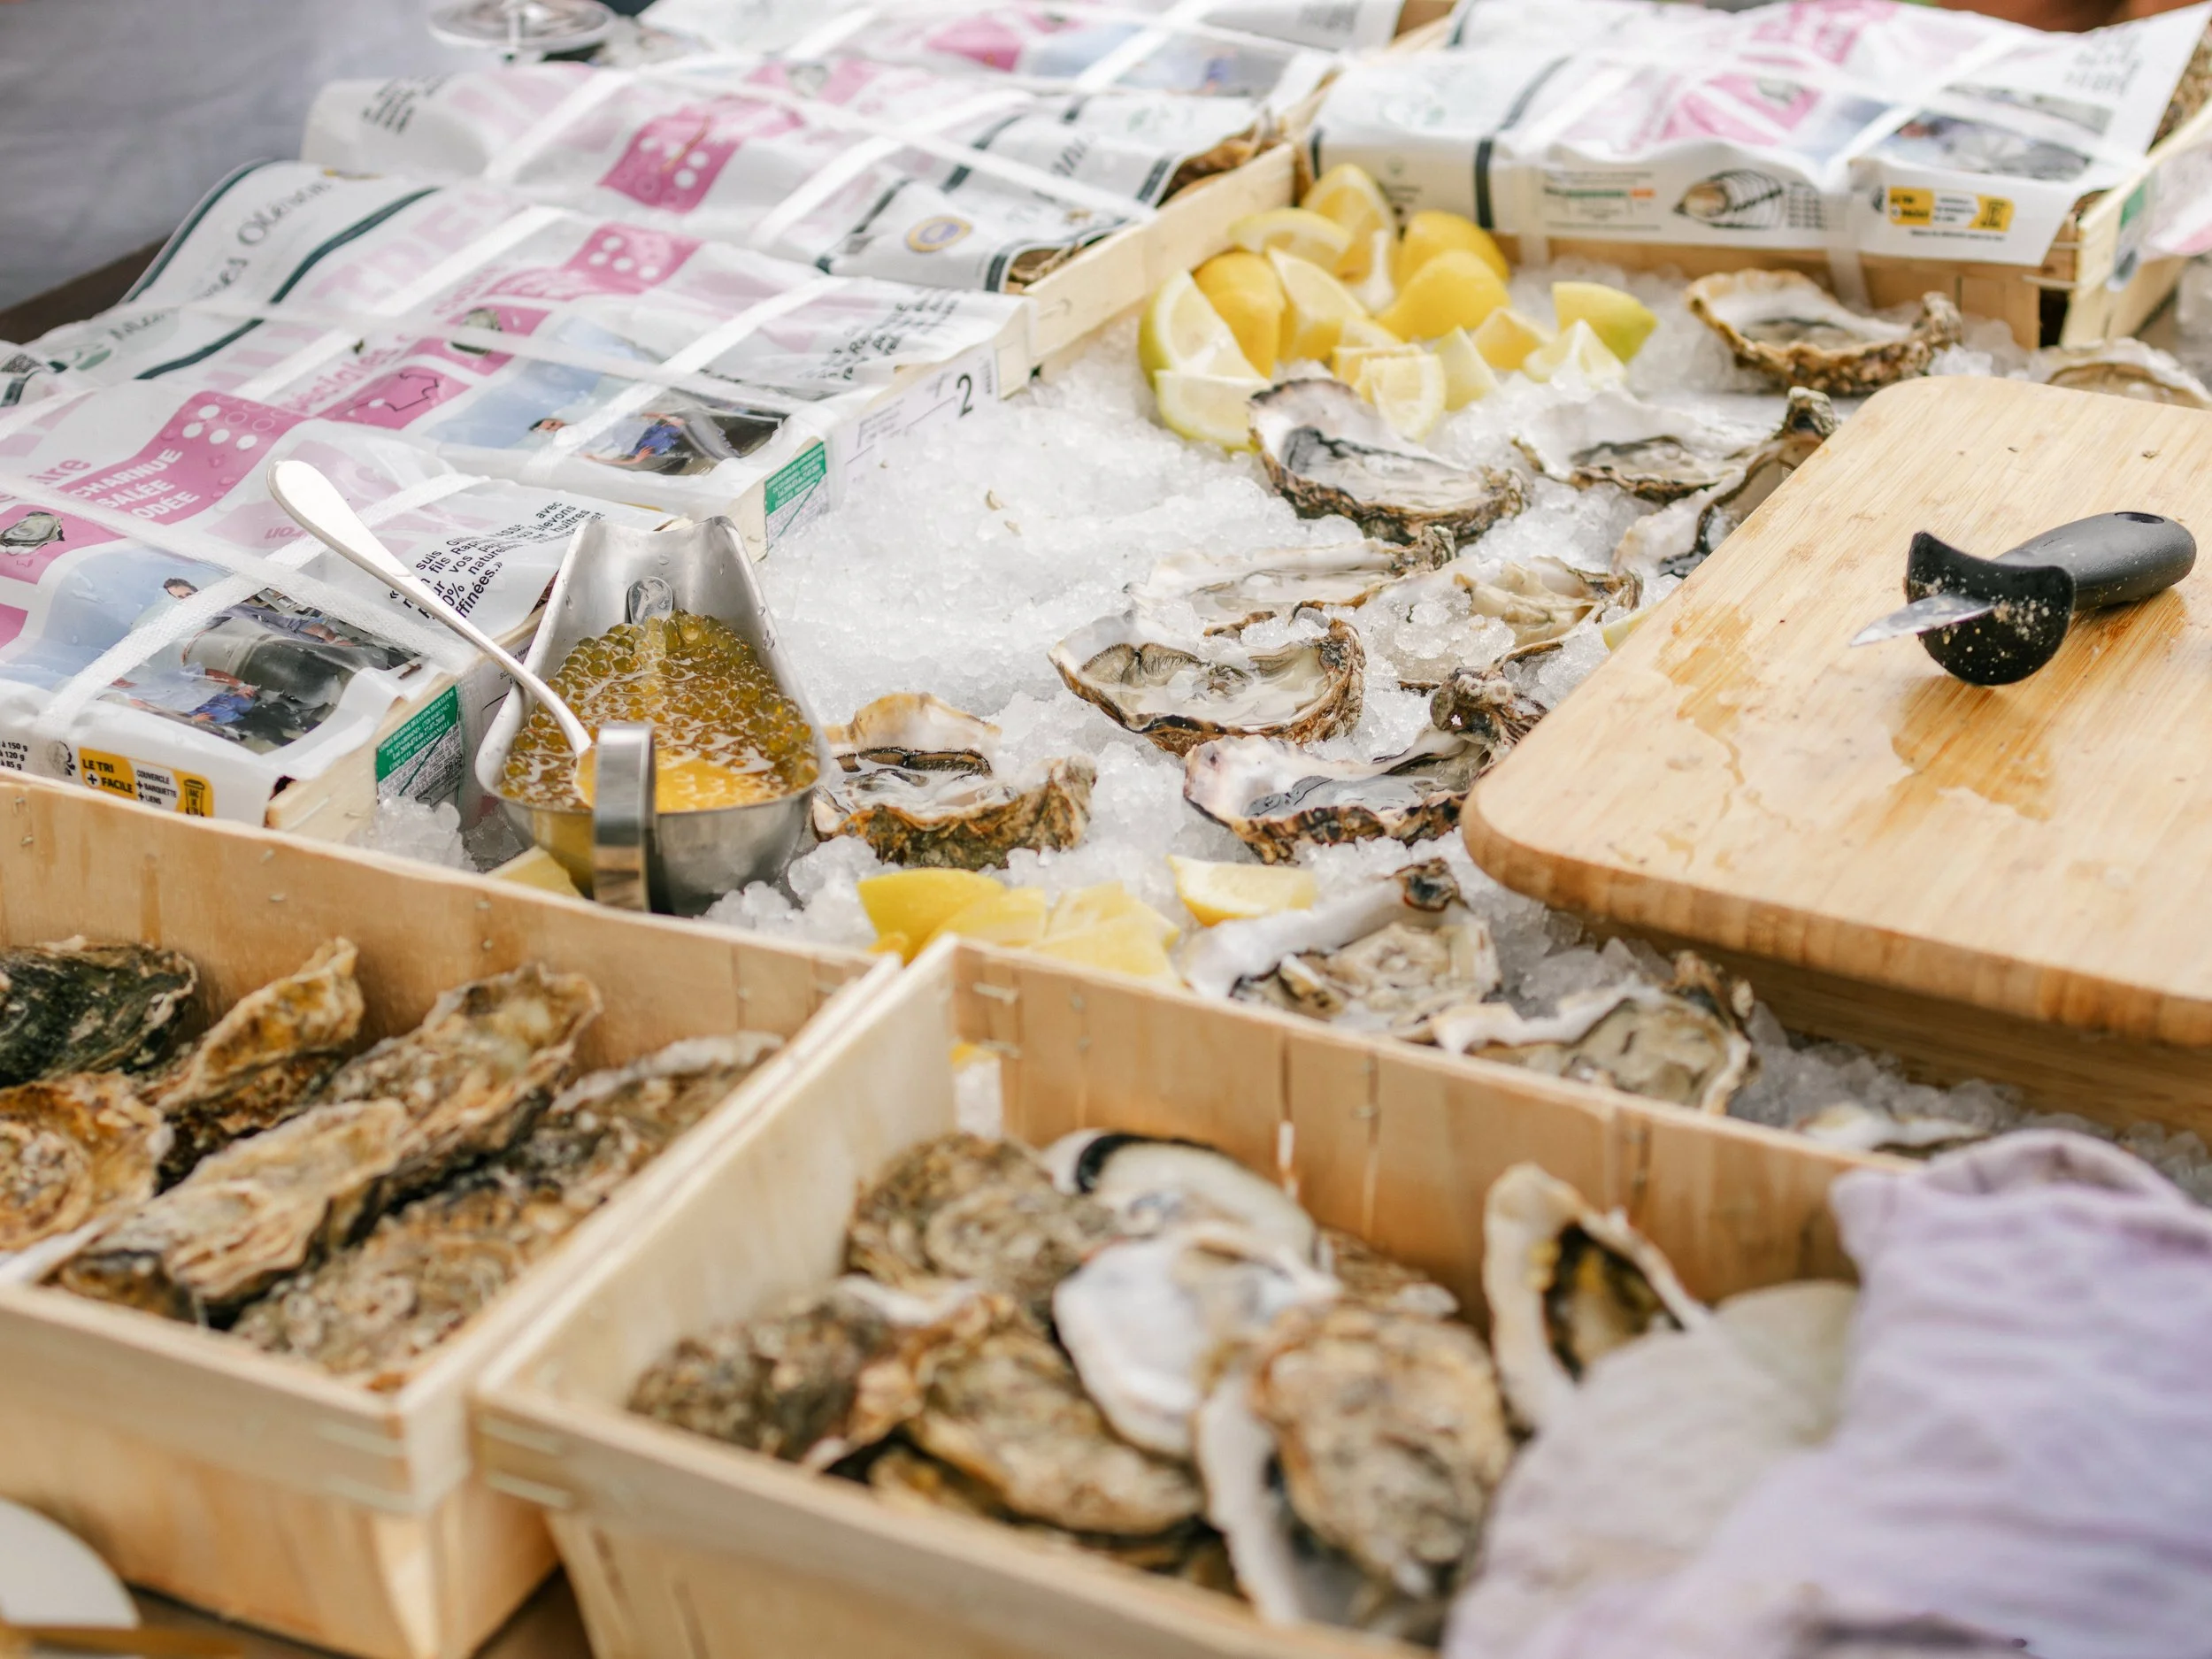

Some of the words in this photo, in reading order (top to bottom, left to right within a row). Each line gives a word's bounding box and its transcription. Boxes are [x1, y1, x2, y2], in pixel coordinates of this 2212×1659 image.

[956, 373, 974, 418] 2
[27, 459, 91, 484] ire
[96, 480, 175, 508] SALÉE
[132, 492, 200, 518] ODÉE
[416, 549, 442, 570] suis
[535, 501, 563, 519] avec
[430, 556, 451, 574] fils
[449, 555, 472, 573] vos
[455, 562, 503, 618] ffinées.»
[82, 759, 95, 770] LE
[97, 762, 114, 772] TRI
[102, 777, 133, 793] FACILE
